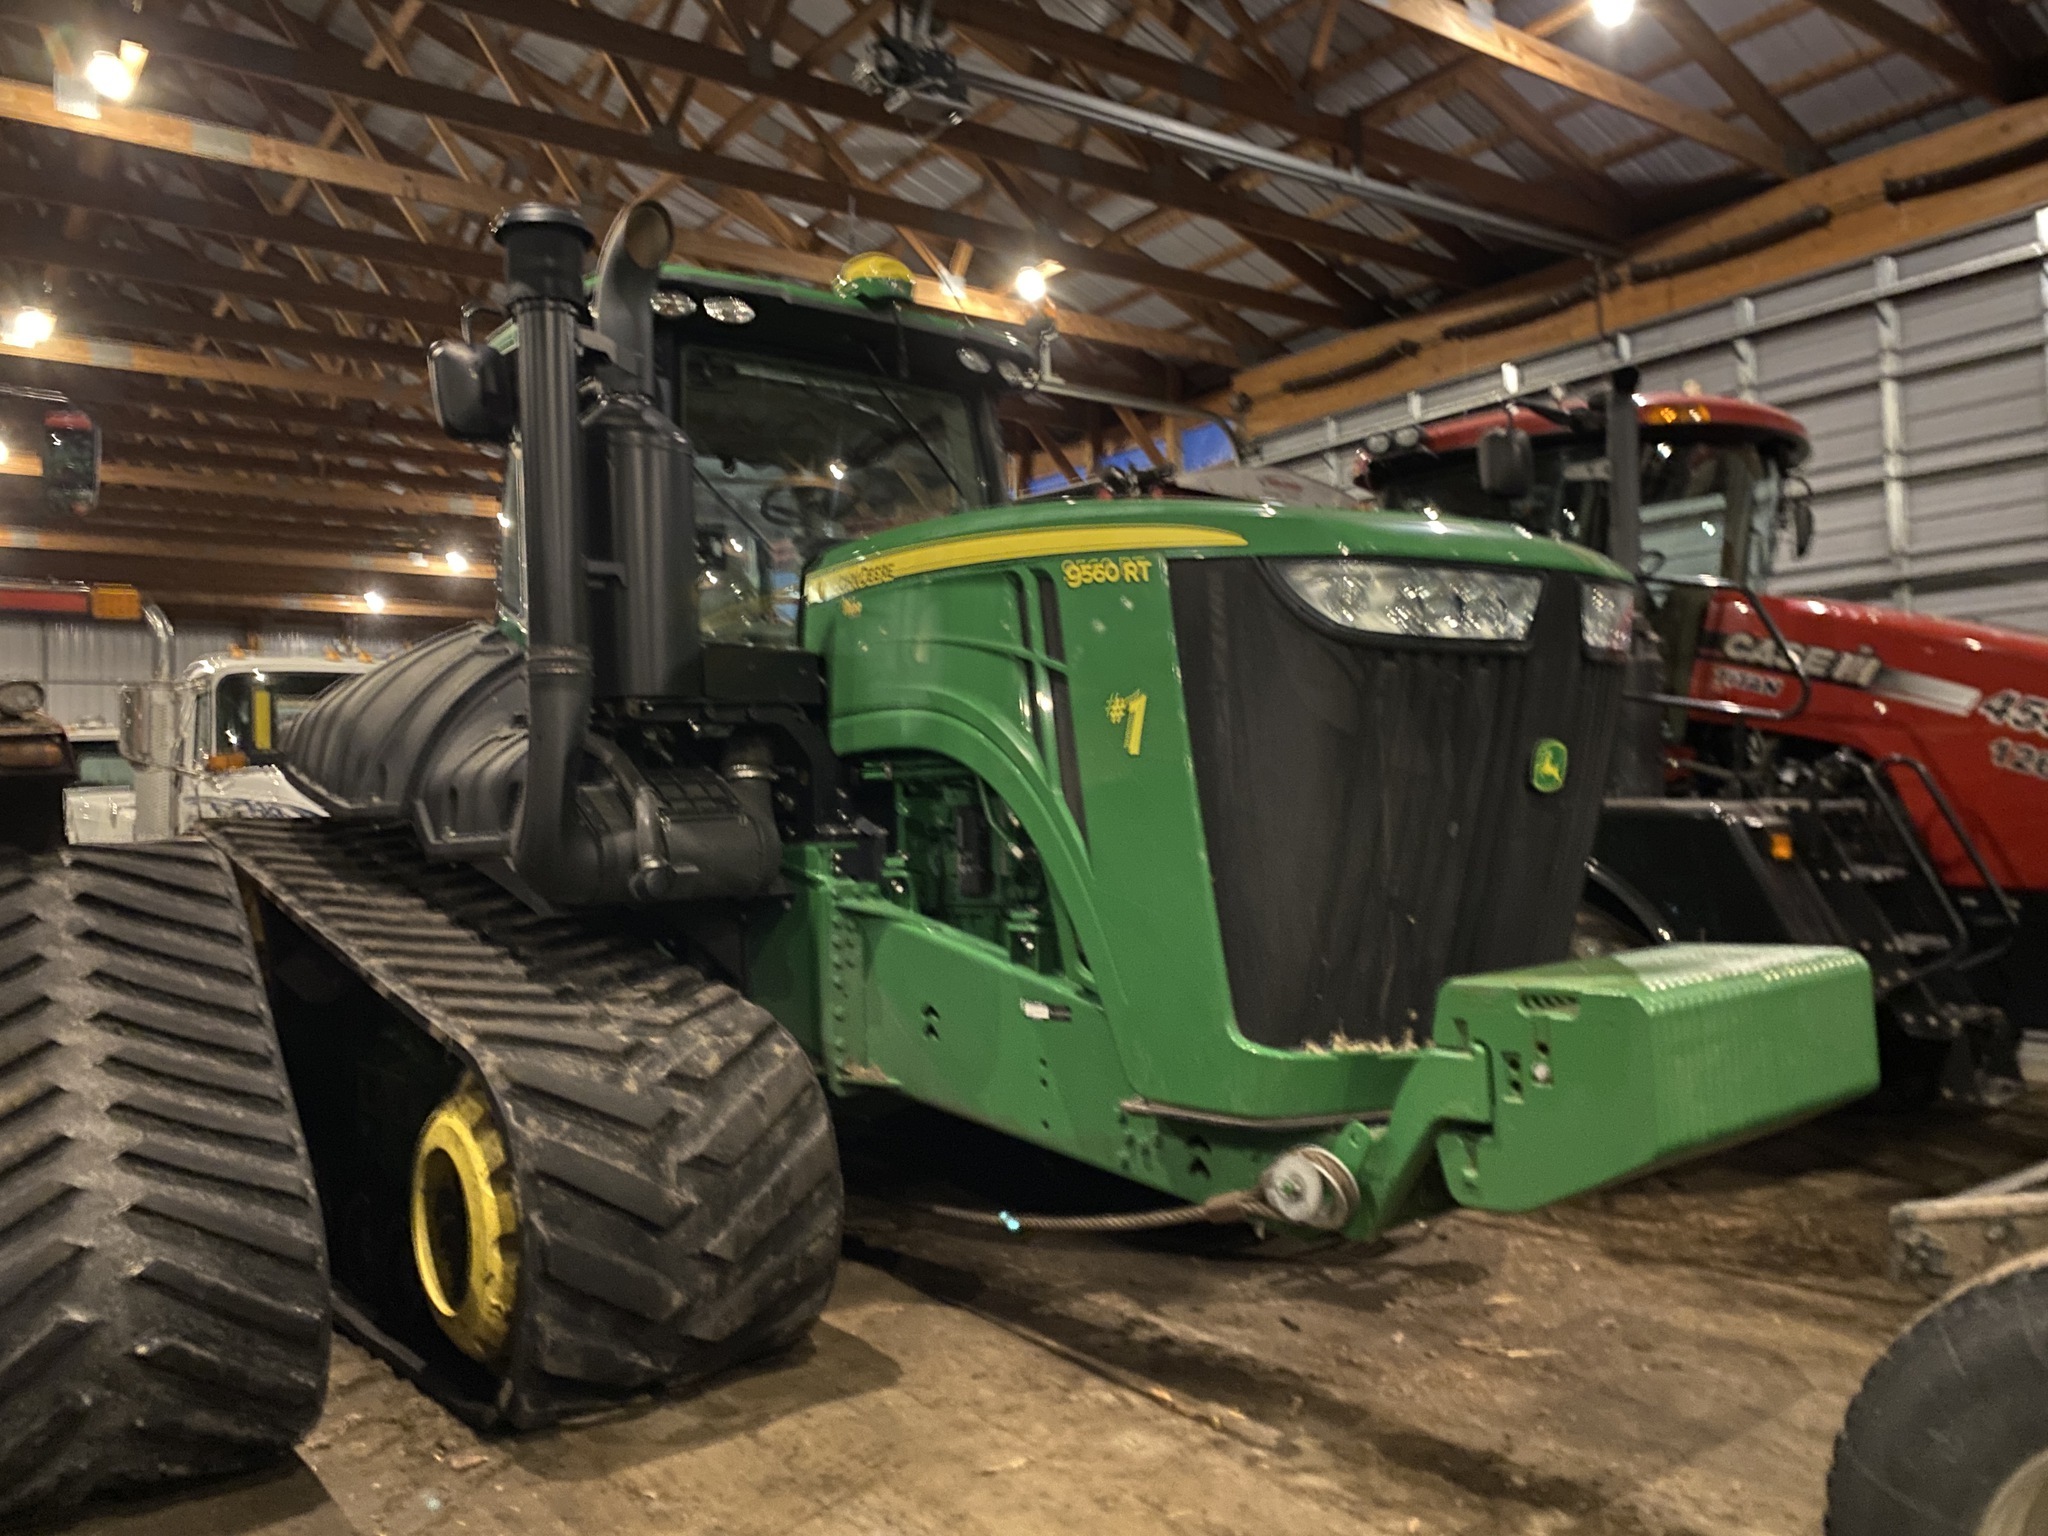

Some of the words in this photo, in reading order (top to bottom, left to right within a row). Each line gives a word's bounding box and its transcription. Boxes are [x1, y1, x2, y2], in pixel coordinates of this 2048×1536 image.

[1062, 557, 1120, 588] 9560
[1120, 556, 1152, 583] RT
[1978, 688, 2048, 738] 45
